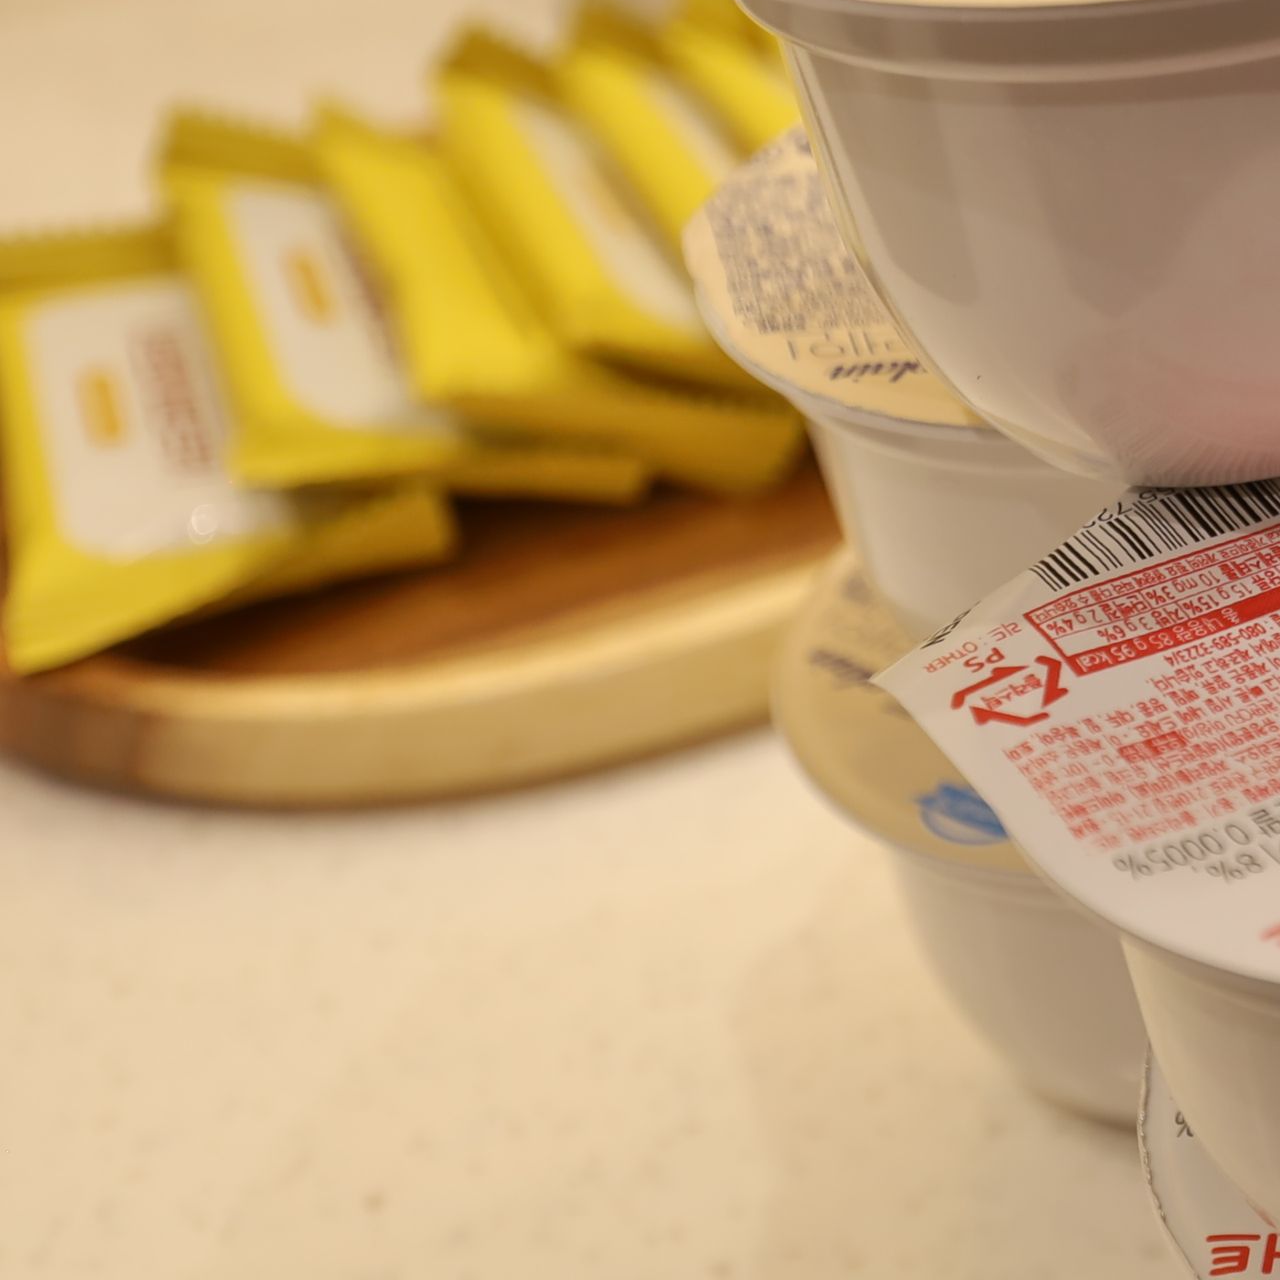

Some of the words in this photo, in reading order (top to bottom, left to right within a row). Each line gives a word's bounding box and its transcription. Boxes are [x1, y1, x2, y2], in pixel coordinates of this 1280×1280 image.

[1097, 591, 1148, 622] 단백질
[1142, 583, 1176, 606] 3%
[1181, 592, 1221, 617] 15%
[1044, 614, 1078, 637] 4%
[1147, 602, 1187, 629] 지방
[1168, 610, 1225, 644] 내용량
[984, 619, 1023, 643] 리드
[1095, 622, 1129, 645] 6%
[1145, 630, 1175, 650] 85
[1161, 621, 1268, 668] 080-589-3223/4
[922, 639, 979, 674] OTHER
[959, 645, 1007, 674] PS
[1073, 647, 1113, 674] kcal
[1107, 641, 1136, 662] 95
[1109, 819, 1253, 886] 0.0005%
